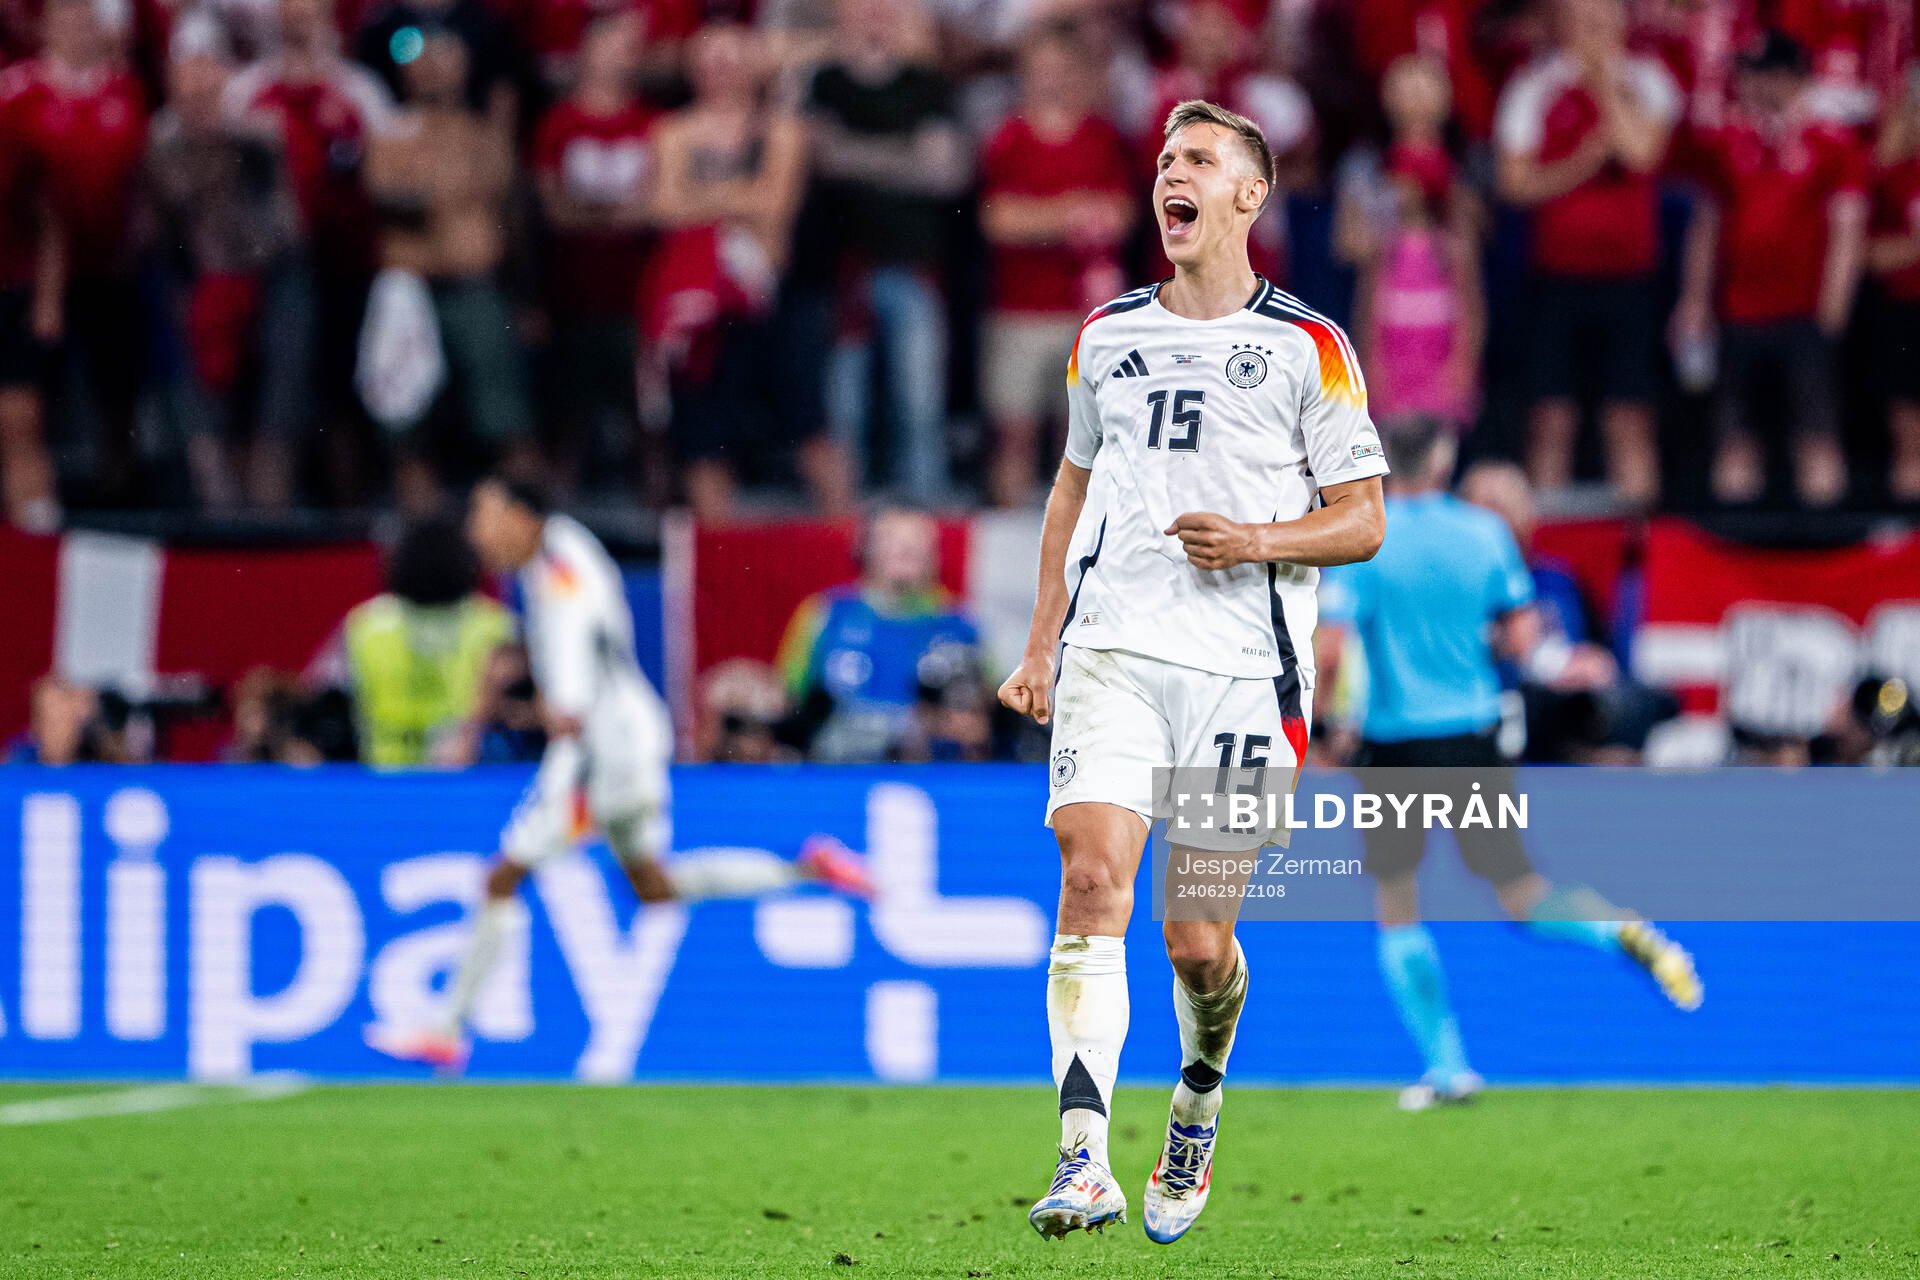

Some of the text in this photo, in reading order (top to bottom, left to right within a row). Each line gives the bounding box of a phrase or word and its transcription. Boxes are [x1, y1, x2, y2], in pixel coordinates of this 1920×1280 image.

[1147, 389, 1205, 453] 15
[1213, 732, 1272, 799] 15
[0, 787, 688, 1082] lipay
